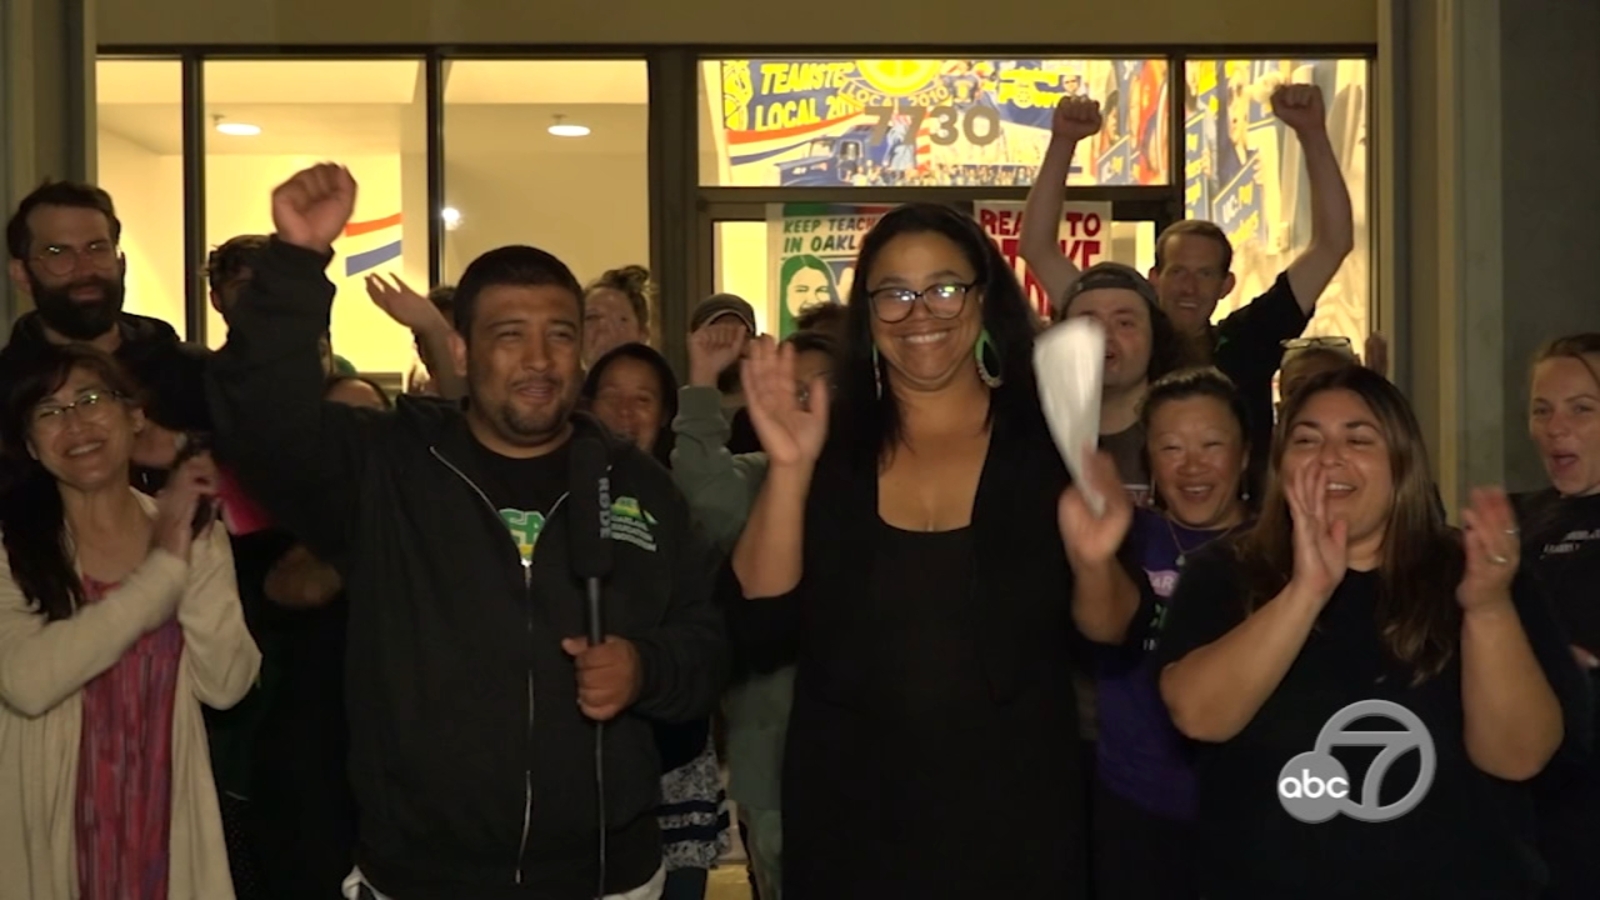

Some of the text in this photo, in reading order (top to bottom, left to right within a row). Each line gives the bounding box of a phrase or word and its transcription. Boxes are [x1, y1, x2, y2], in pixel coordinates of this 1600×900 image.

[755, 98, 821, 131] LOCAL
[864, 105, 1001, 146] 7730
[783, 219, 822, 233] KEEP
[1066, 211, 1101, 237] TO
[784, 236, 804, 253] IN
